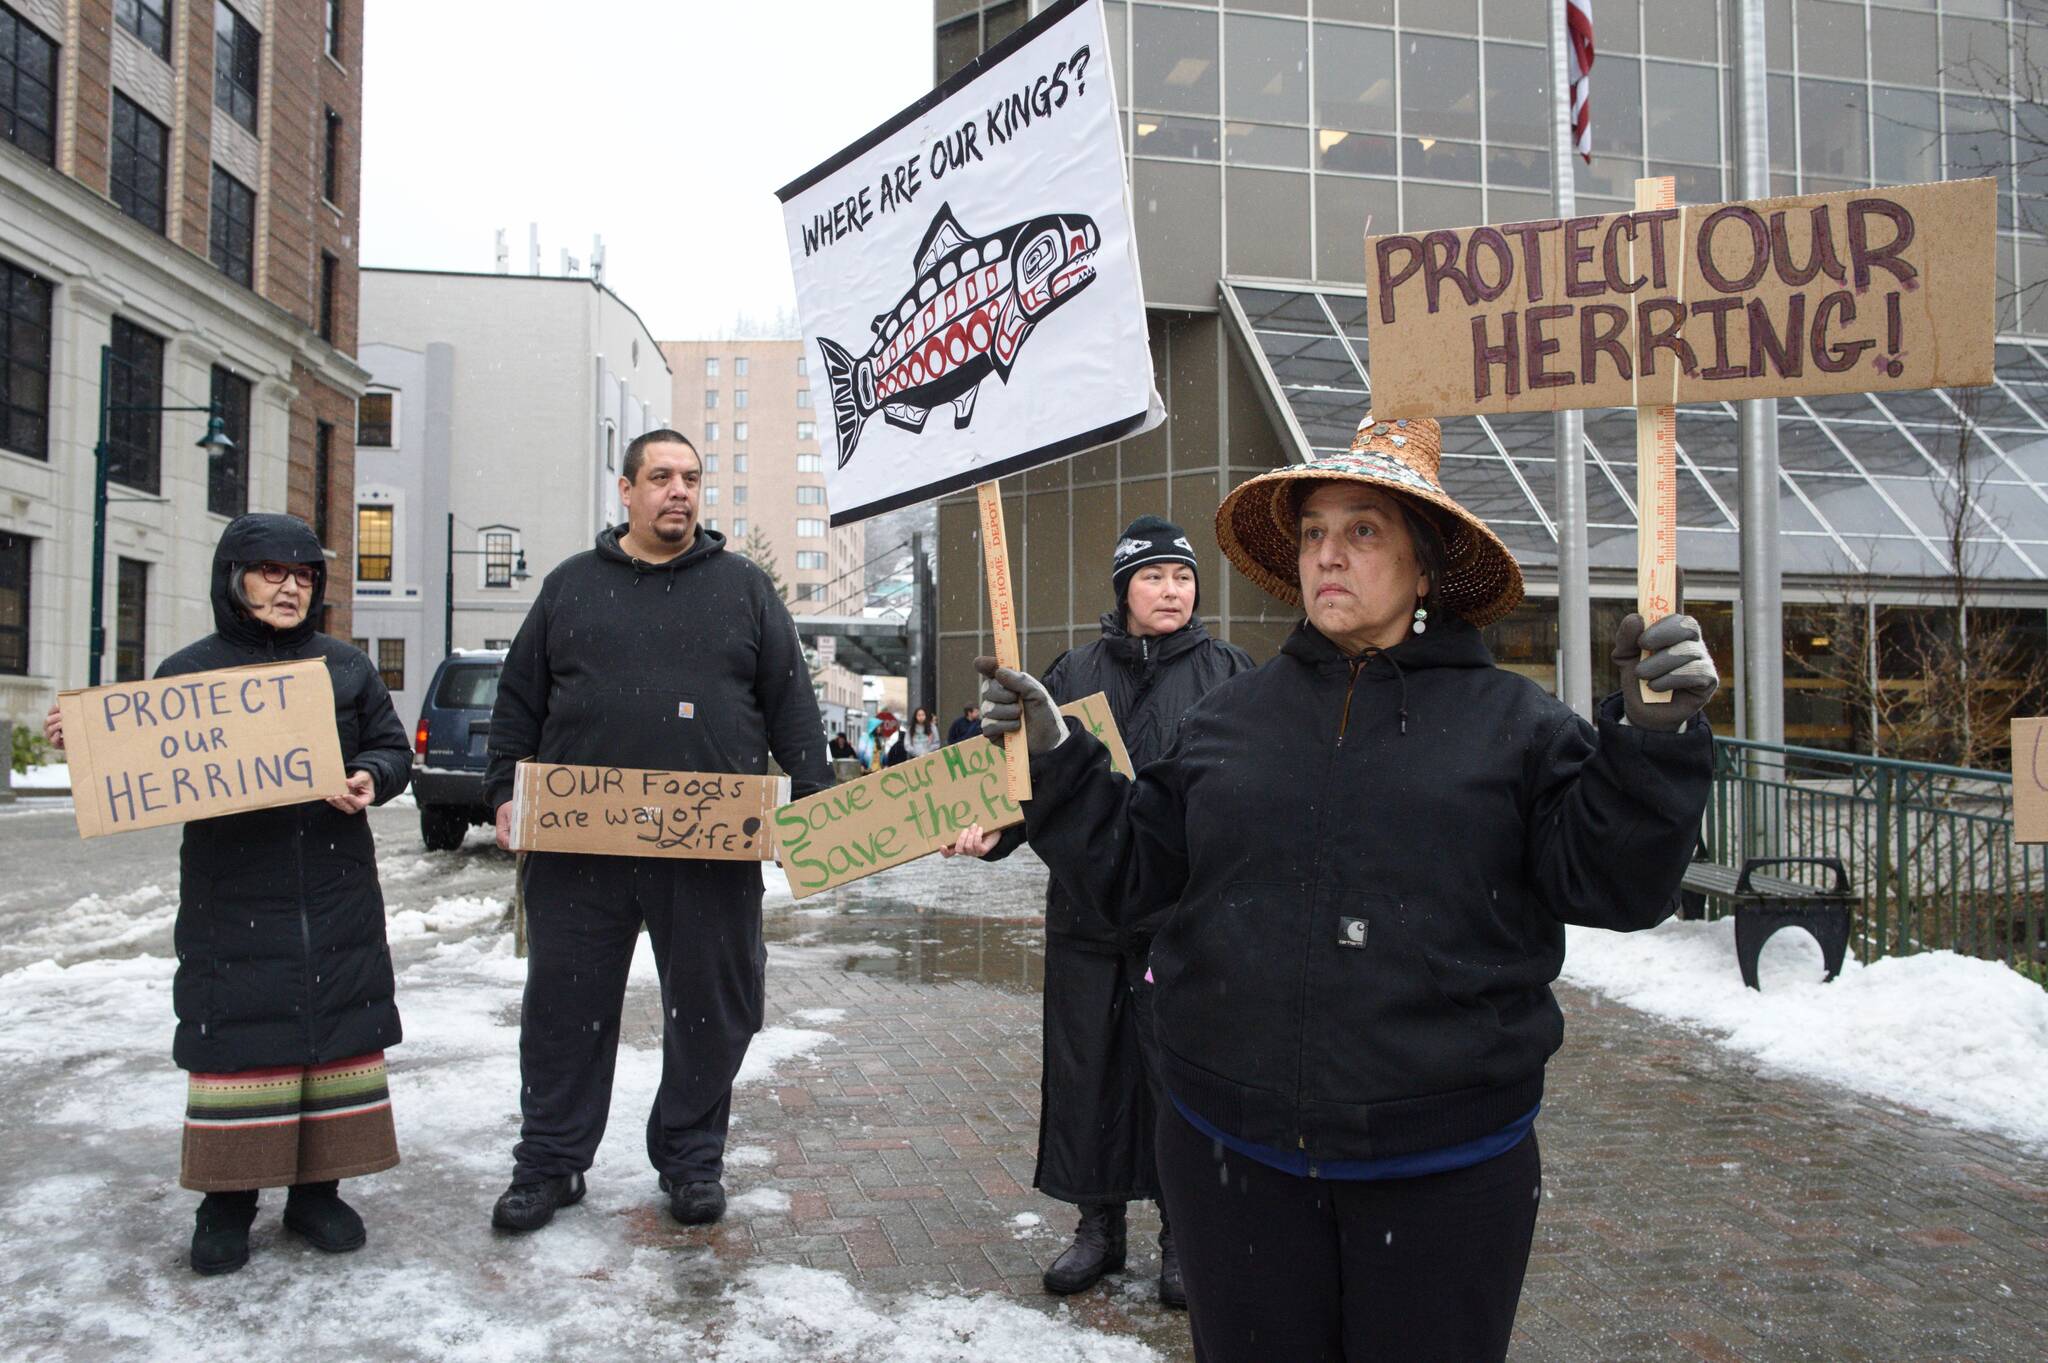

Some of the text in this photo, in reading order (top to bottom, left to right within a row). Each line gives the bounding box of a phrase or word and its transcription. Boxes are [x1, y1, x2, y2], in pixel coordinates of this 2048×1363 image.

[801, 44, 1091, 257] WHERE ARE OUR KINGS?
[1375, 198, 1921, 325] PROTECT OUR
[1471, 290, 1905, 402] HERRING!
[987, 500, 1001, 546] DEPOT
[994, 554, 1008, 598] HOME
[1000, 601, 1011, 632] THE
[103, 674, 295, 732] PROTECT
[160, 726, 228, 759] OUR
[106, 747, 314, 823] HERRING
[546, 767, 744, 799] OUR Foods
[774, 783, 873, 847] Save
[880, 759, 934, 801] our
[540, 809, 589, 829] are
[605, 806, 663, 842] way
[672, 796, 721, 823] of
[790, 825, 906, 889] Save
[904, 792, 982, 841] the
